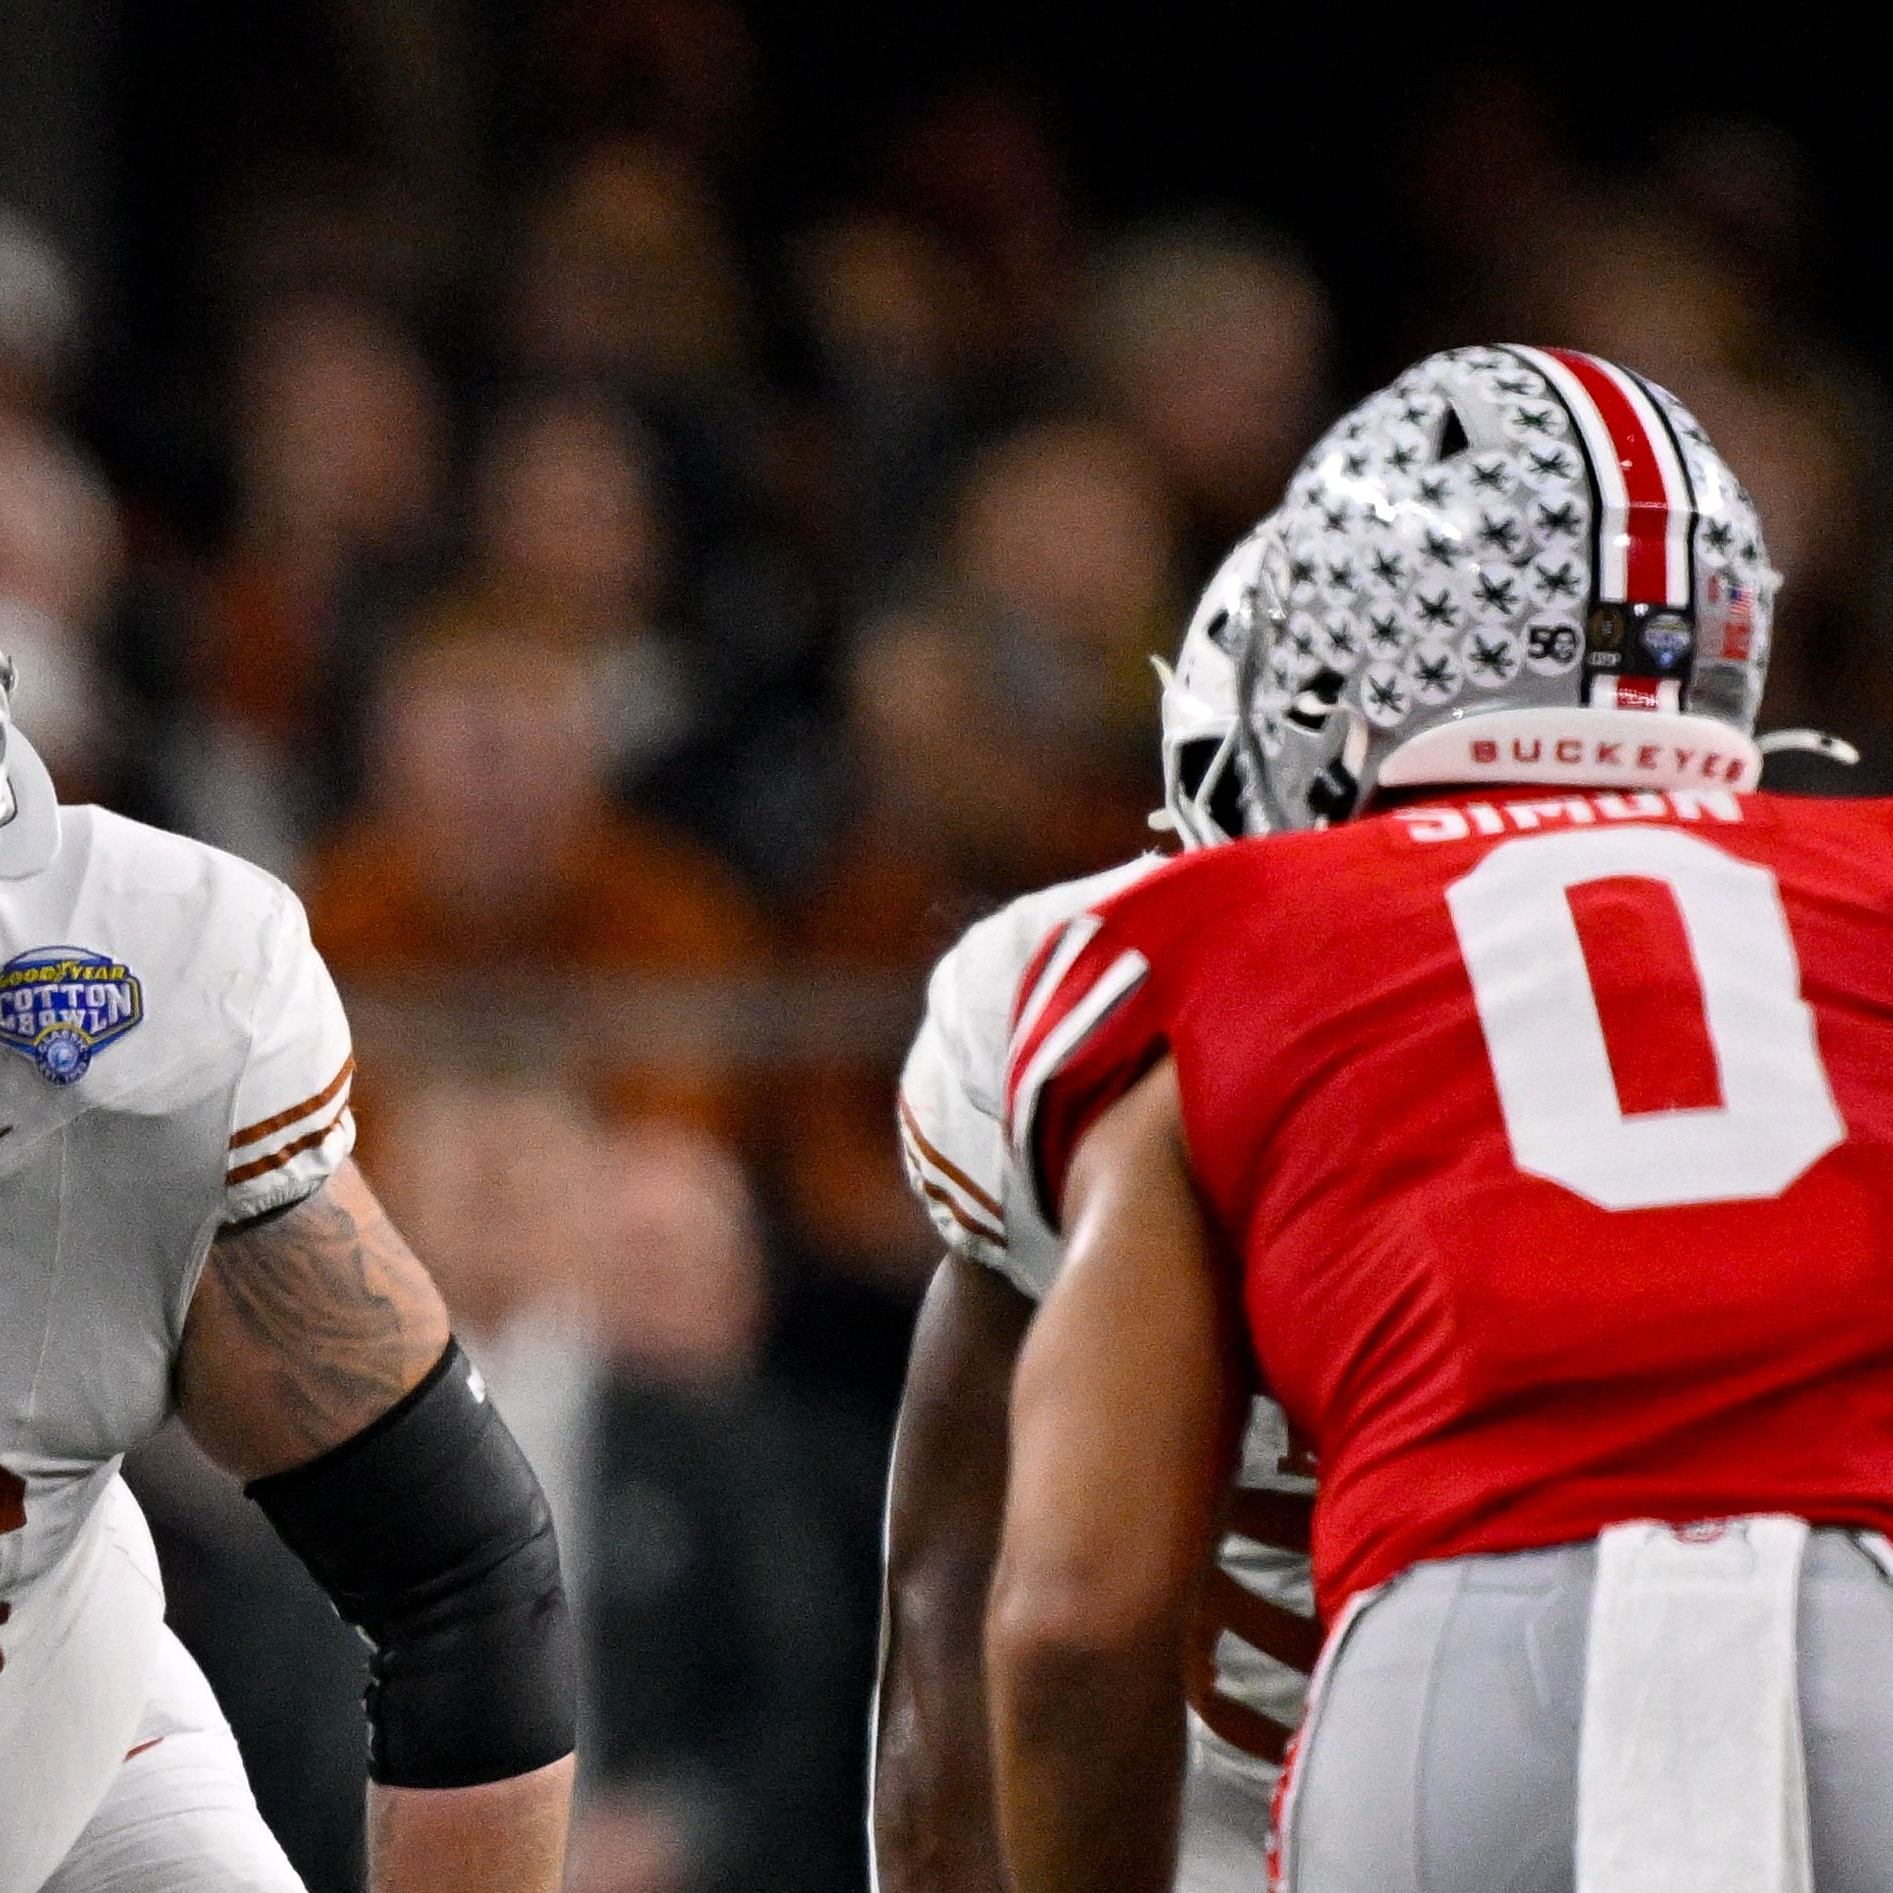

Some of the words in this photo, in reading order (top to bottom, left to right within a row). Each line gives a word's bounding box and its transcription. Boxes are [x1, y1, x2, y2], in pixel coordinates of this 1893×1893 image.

[1394, 790, 1744, 842] SIMON
[18, 1009, 108, 1036] BOWL
[1445, 829, 1847, 1211] 0
